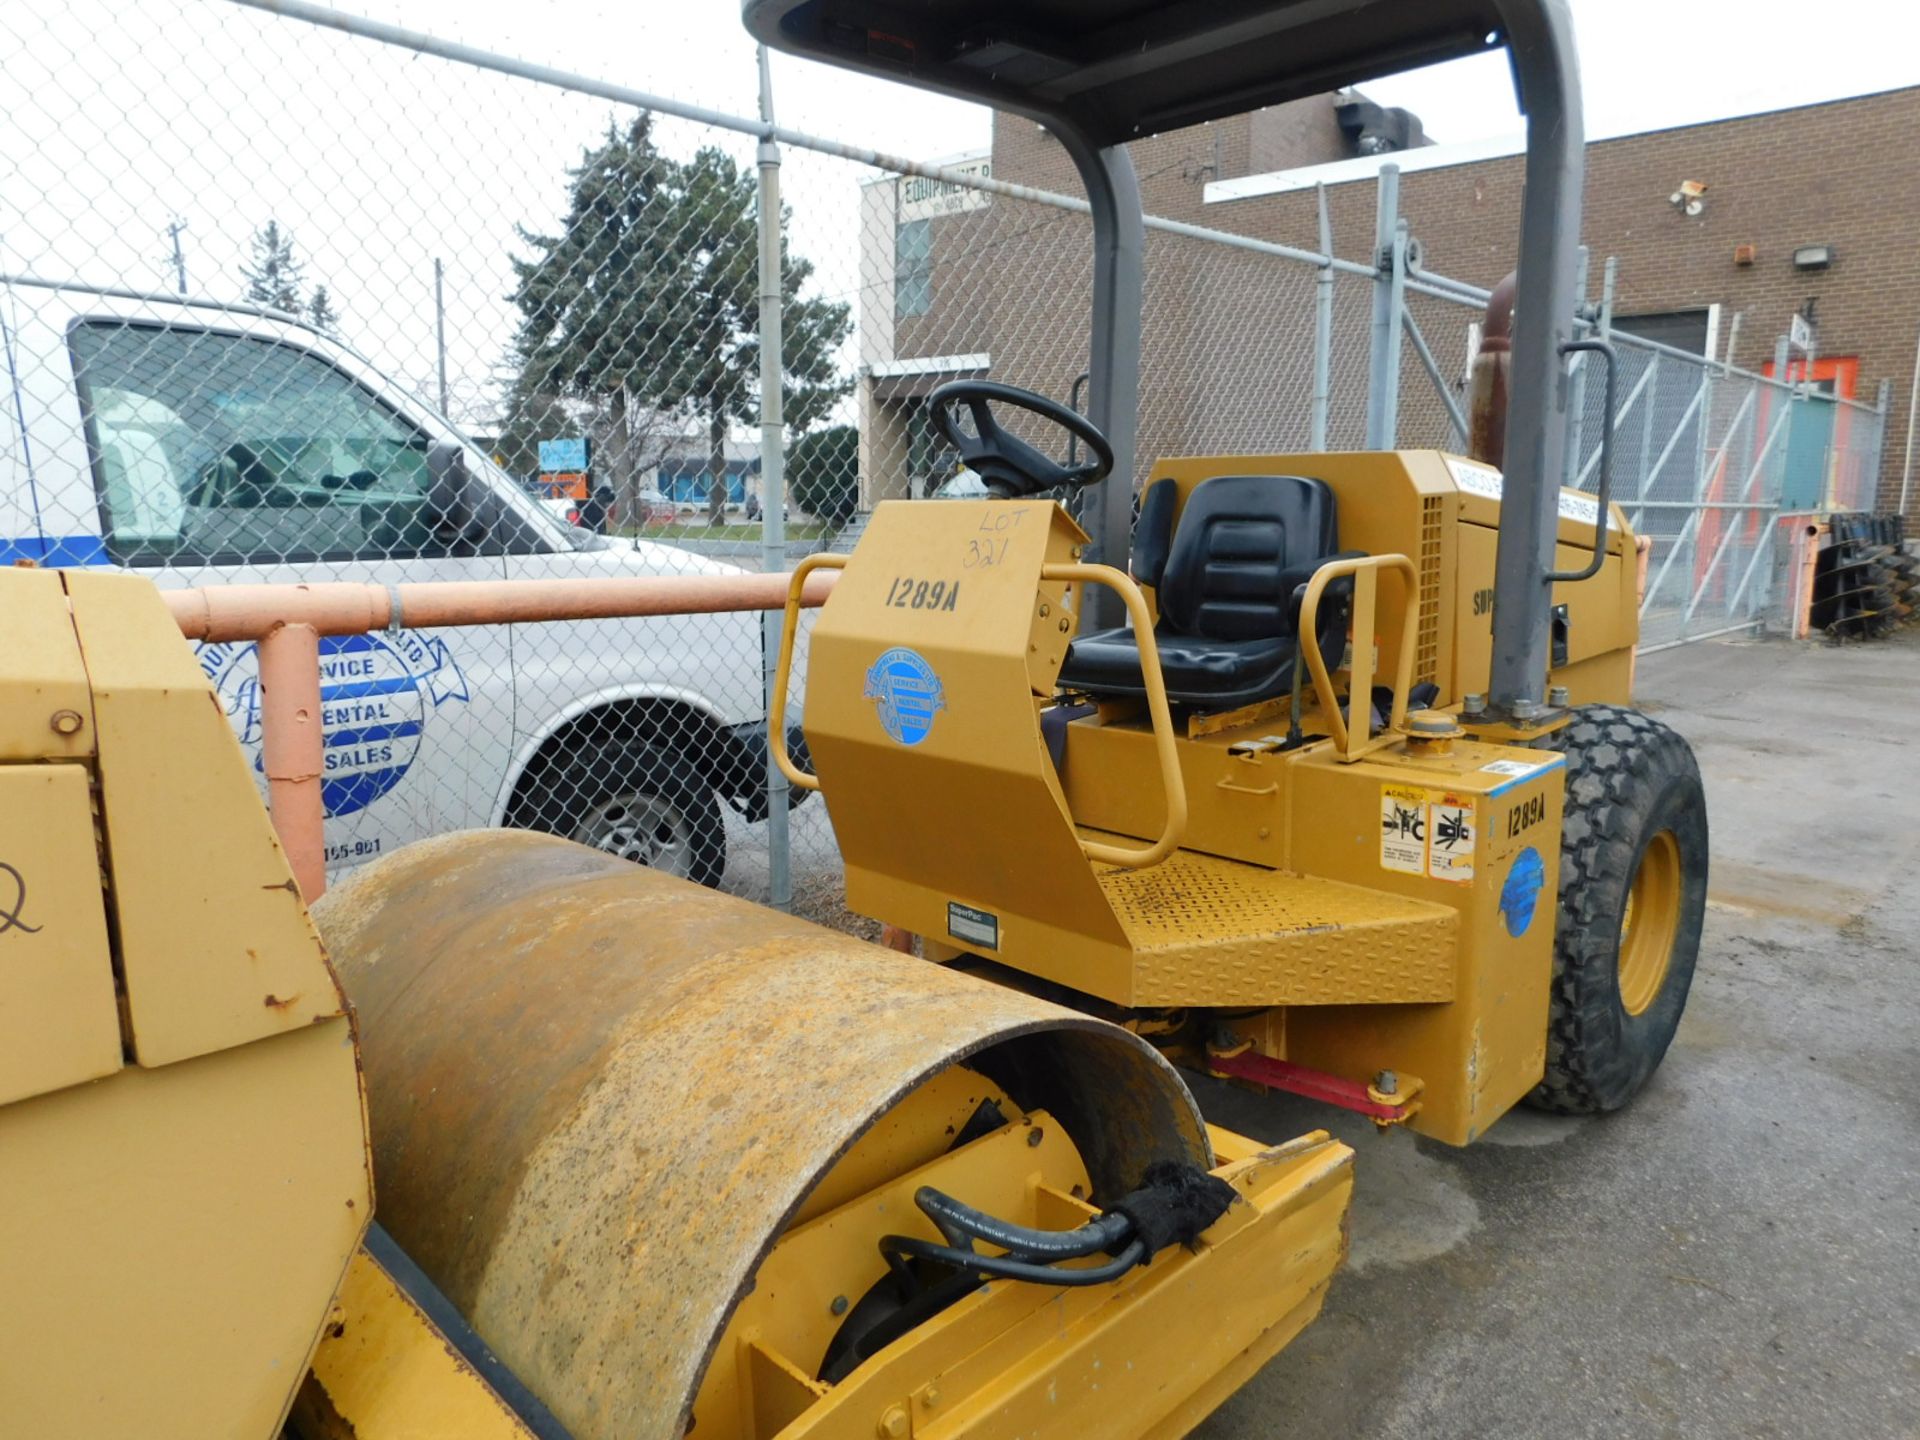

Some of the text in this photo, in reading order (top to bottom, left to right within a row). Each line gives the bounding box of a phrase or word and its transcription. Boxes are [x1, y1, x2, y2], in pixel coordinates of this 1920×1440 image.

[906, 166, 977, 204] EQUIPME
[979, 508, 1030, 532] LOT
[962, 537, 1009, 568] 321
[885, 577, 960, 612] 1289A
[1472, 590, 1493, 616] SUP
[320, 658, 375, 681] VICE
[322, 703, 390, 726] ENTAL
[325, 746, 392, 770] SALES
[1507, 792, 1545, 840] 1289A
